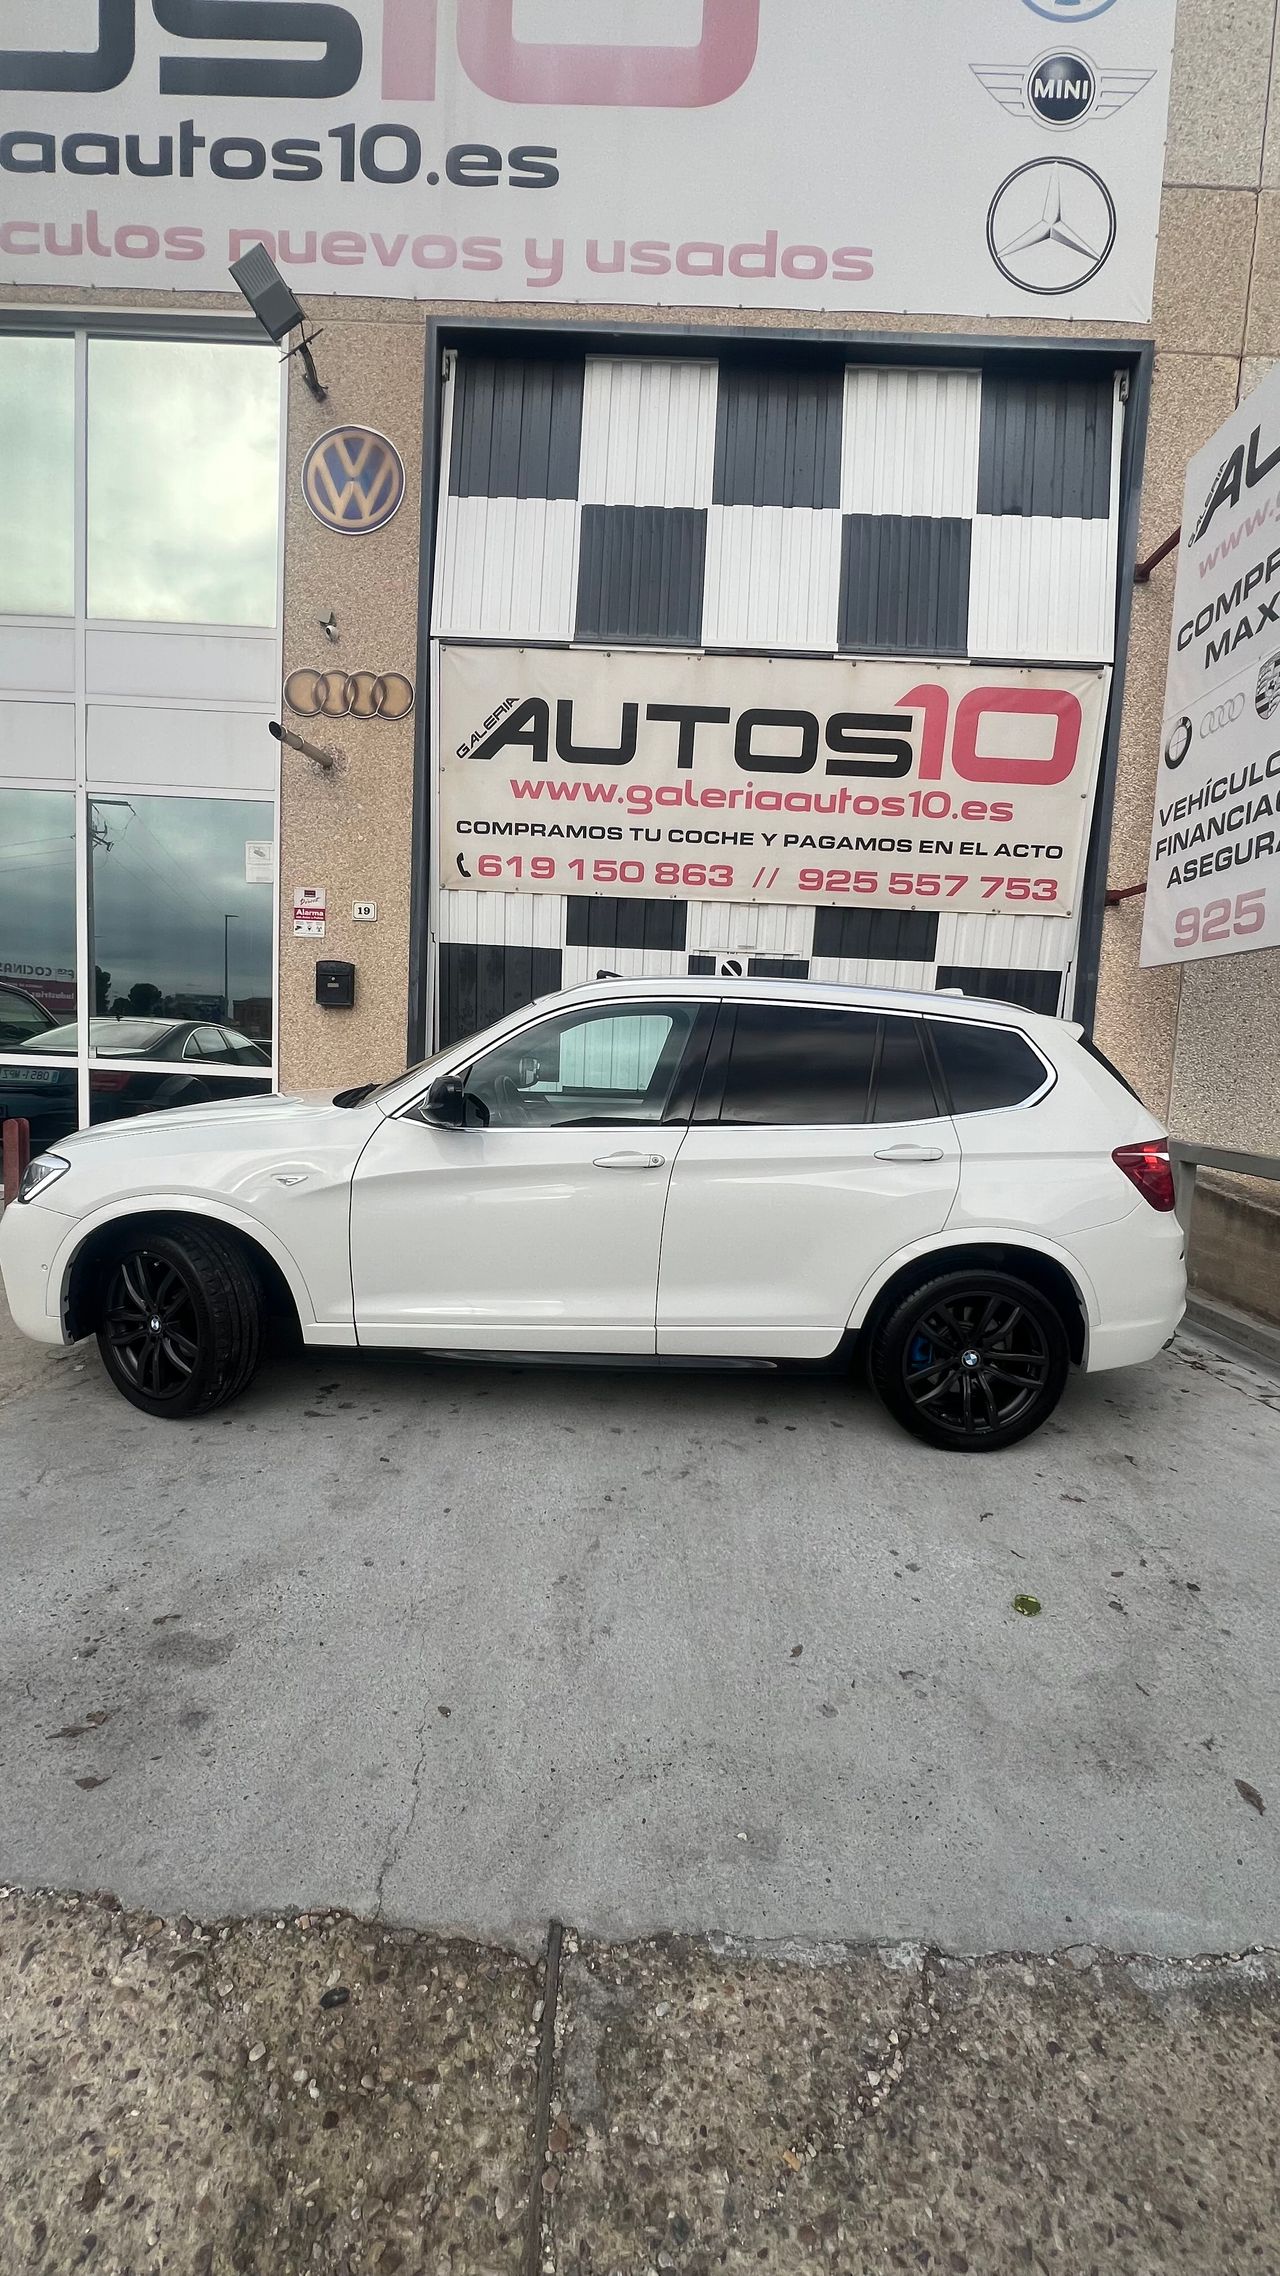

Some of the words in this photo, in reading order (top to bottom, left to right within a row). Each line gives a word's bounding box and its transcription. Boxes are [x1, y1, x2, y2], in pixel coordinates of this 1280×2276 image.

[1034, 78, 1089, 101] MINI
[228, 227, 503, 272] nuevos
[524, 237, 565, 288] y
[586, 229, 875, 282] usados
[1199, 490, 1280, 579] www.
[455, 697, 521, 761] GALERIA
[467, 683, 1083, 786] AUTOS10
[509, 778, 1014, 823] www.galeriaautos10.es
[1155, 789, 1280, 862] FINANCIA
[456, 819, 623, 841] COMPRAMOS
[629, 827, 662, 843] TU
[667, 828, 754, 846] COCHE
[761, 832, 778, 847] Y
[783, 833, 913, 854] PAGAMOS
[919, 840, 954, 855] EN
[959, 841, 989, 857] EL
[993, 843, 1064, 860] ACTO
[1166, 830, 1280, 889] ASEGUR
[477, 854, 556, 879] 619
[567, 858, 645, 884] 150
[654, 862, 734, 888] 863
[798, 867, 879, 894] 925
[888, 872, 969, 898] 557
[979, 875, 1059, 902] 753
[296, 908, 324, 916] Alarma
[357, 906, 371, 916] 19
[1173, 887, 1267, 948] 925
